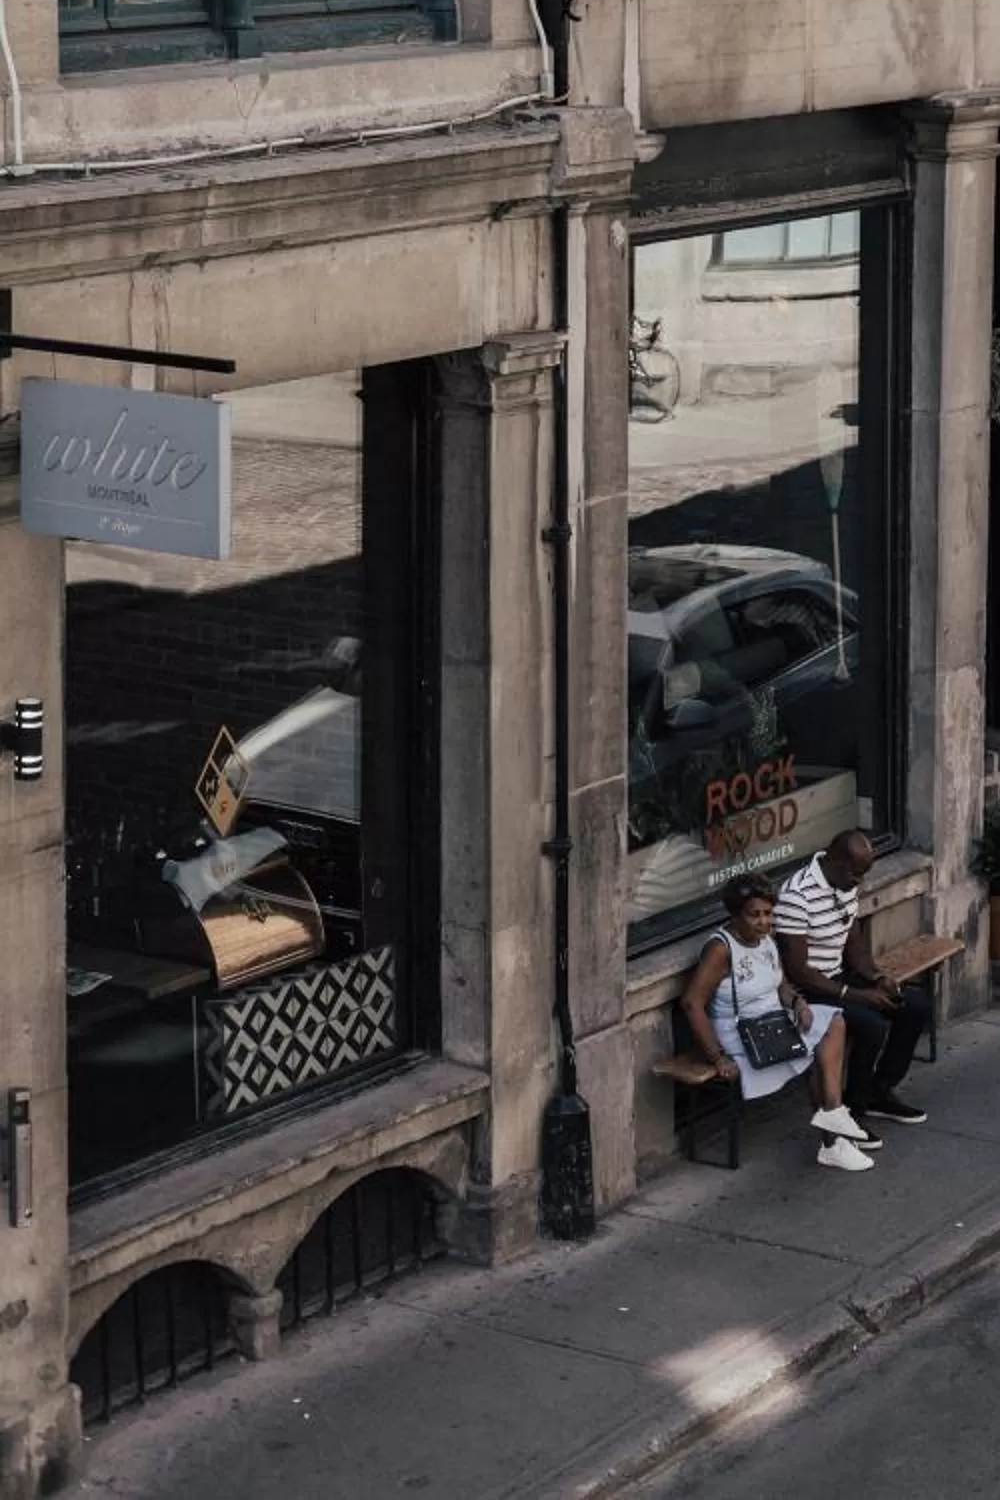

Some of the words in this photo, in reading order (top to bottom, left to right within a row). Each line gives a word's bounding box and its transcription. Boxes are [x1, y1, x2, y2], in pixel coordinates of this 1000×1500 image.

[42, 406, 207, 490] white
[706, 753, 798, 825] ROCK
[705, 798, 798, 864] WOOD
[708, 861, 745, 887] BISTRO
[747, 843, 794, 871] CANADIEN
